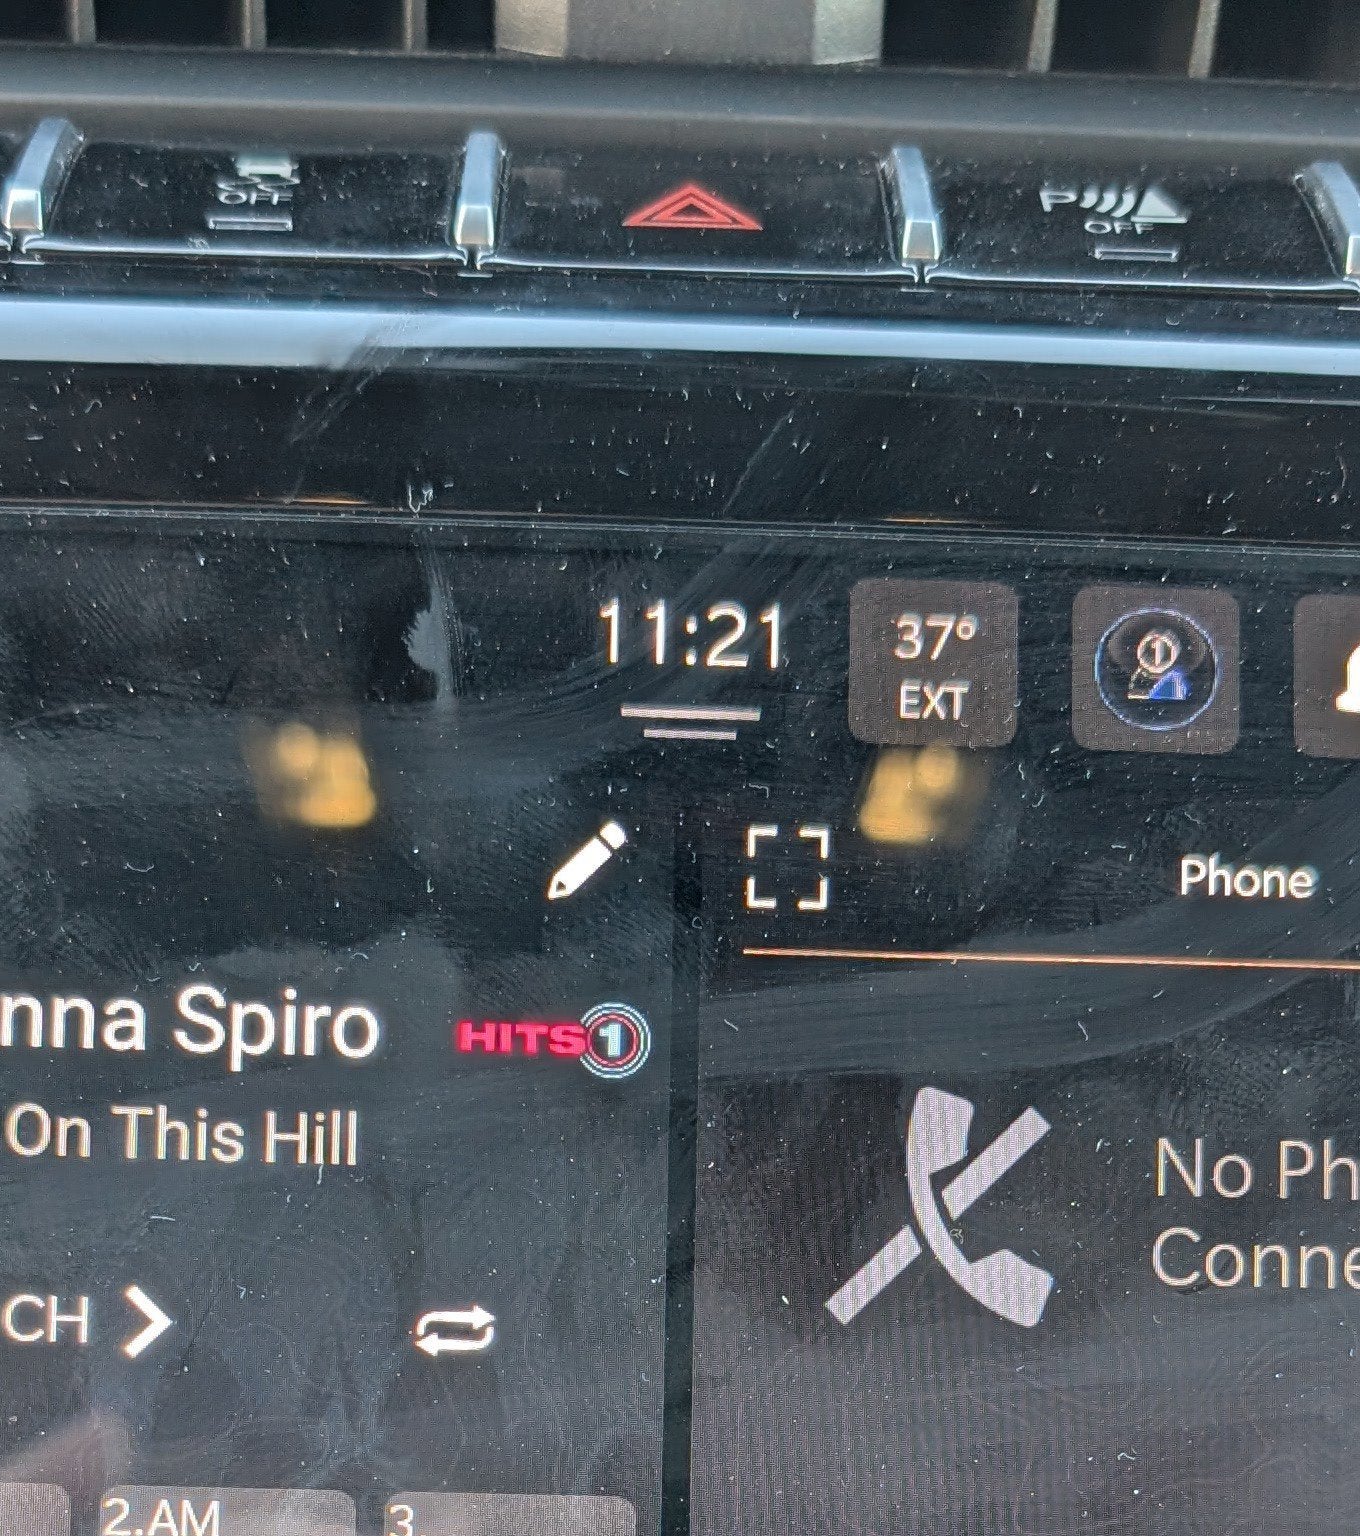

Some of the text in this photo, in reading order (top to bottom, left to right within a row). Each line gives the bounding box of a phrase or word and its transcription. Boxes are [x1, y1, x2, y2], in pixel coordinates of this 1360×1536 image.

[218, 190, 293, 205] OFF
[1084, 220, 1155, 234] OFF
[598, 598, 783, 668] 11:21
[899, 681, 970, 721] EXT
[1180, 854, 1317, 898] Phone
[171, 984, 381, 1073] Spiro
[6, 1103, 93, 1158] On
[112, 1104, 244, 1165] This
[263, 1109, 360, 1168] Hill
[1155, 1136, 1253, 1198] No
[1, 1294, 89, 1343] CH
